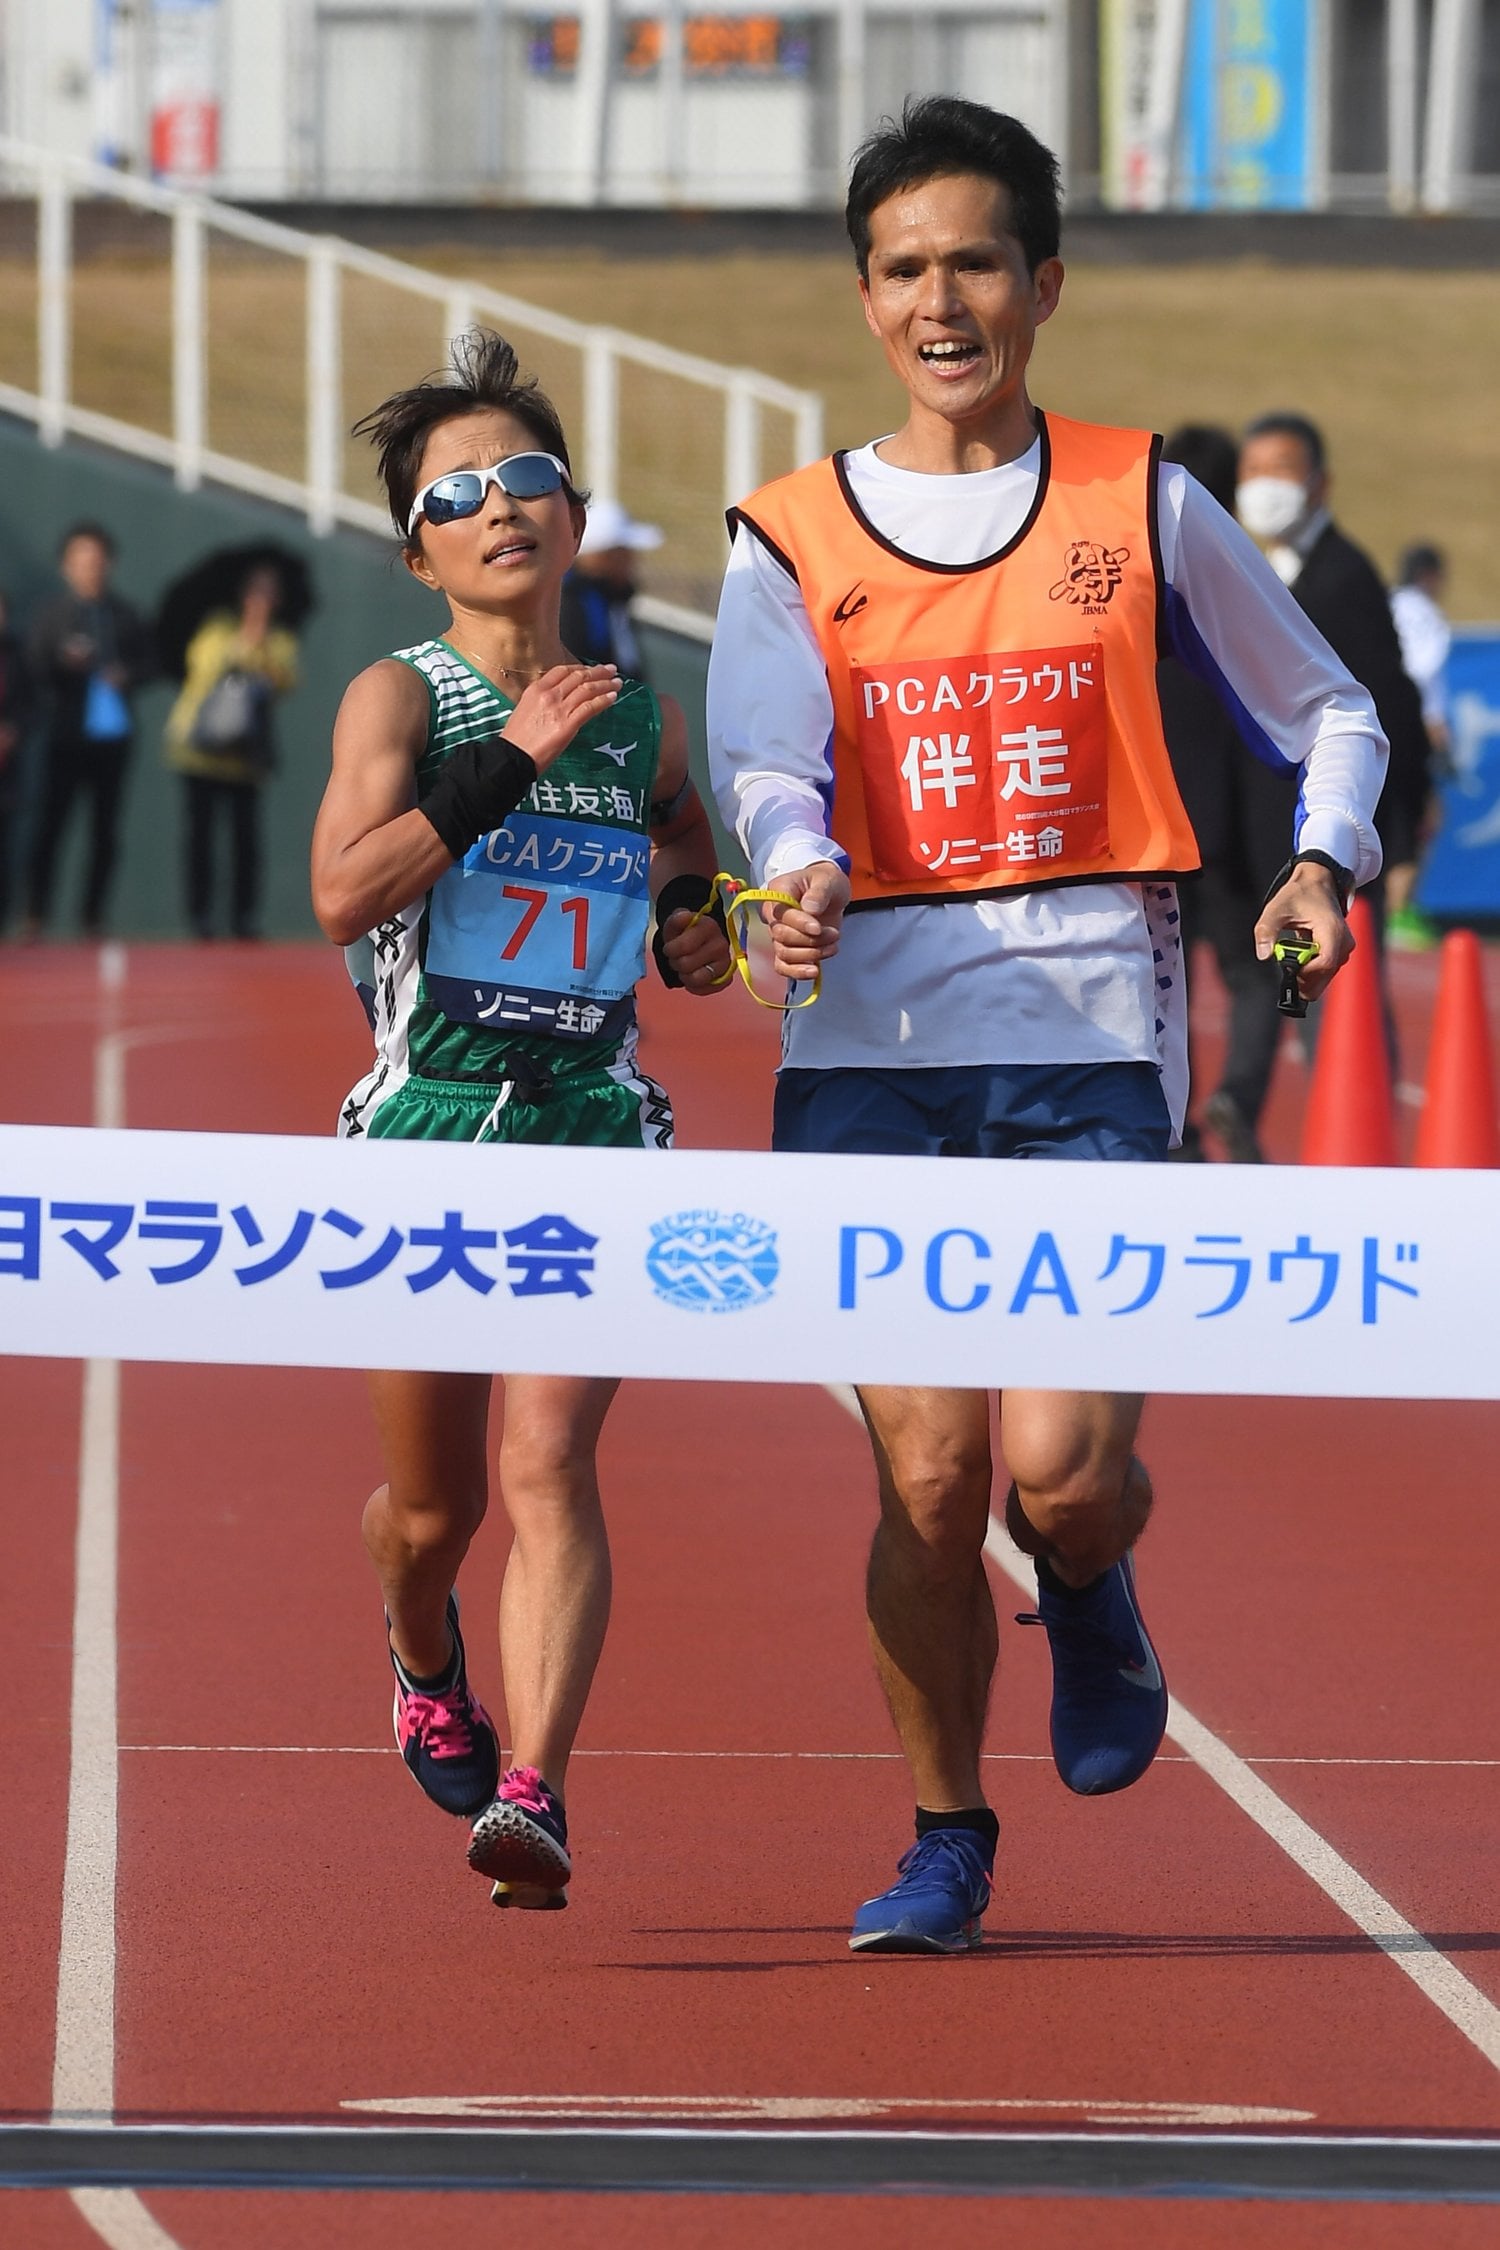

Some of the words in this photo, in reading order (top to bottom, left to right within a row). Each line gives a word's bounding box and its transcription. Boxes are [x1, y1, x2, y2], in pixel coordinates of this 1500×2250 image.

[1081, 606, 1108, 616] JBMA
[863, 661, 1093, 719] PCAクラウド
[900, 725, 1072, 812] 伴走
[515, 779, 644, 824] 住友海
[479, 829, 646, 883] CAクラウド
[919, 826, 1064, 872] ソニー生命
[501, 885, 590, 970] 71
[474, 987, 607, 1034] ソニー生命
[837, 1224, 1421, 1327] PCAクラウド
